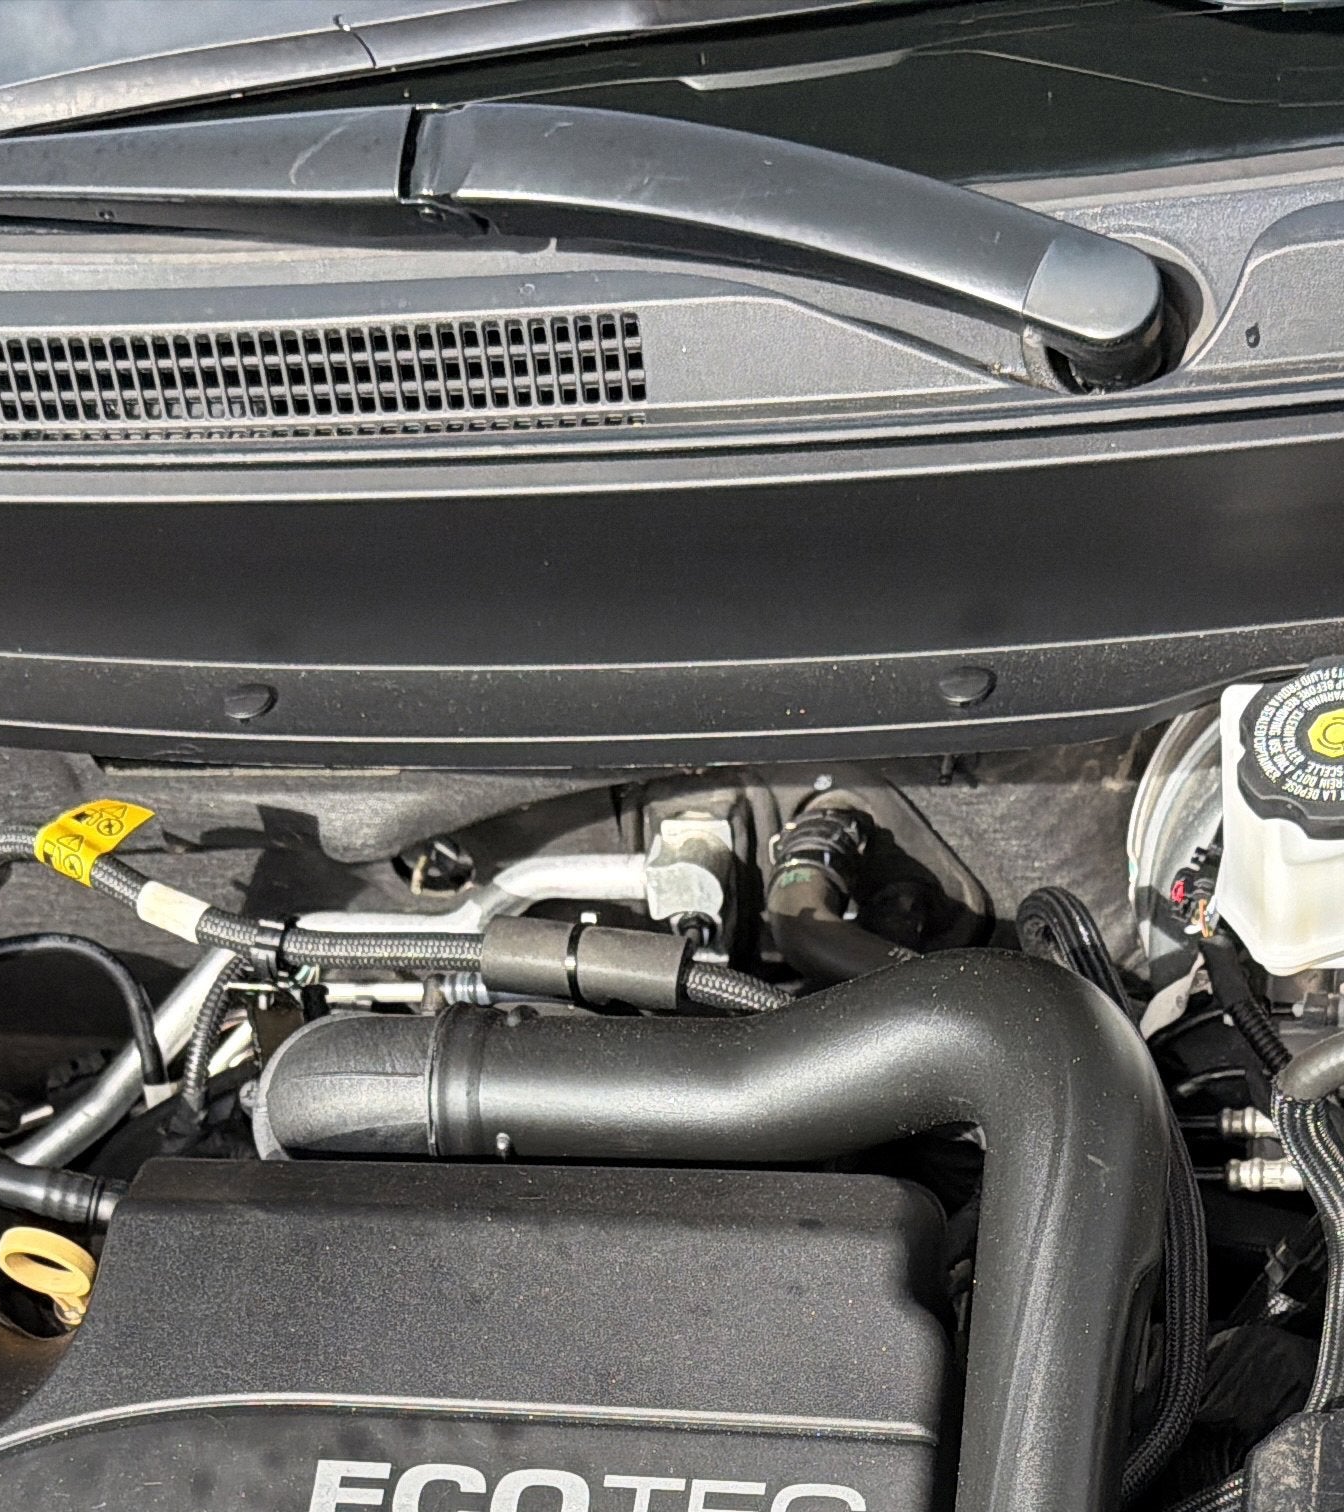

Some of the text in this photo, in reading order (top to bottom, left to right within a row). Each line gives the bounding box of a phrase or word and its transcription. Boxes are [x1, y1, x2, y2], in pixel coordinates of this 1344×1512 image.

[1300, 669, 1330, 688] FLUID
[1276, 680, 1302, 702] FROM
[1292, 769, 1317, 787] DOT3
[1321, 789, 1337, 801] LA
